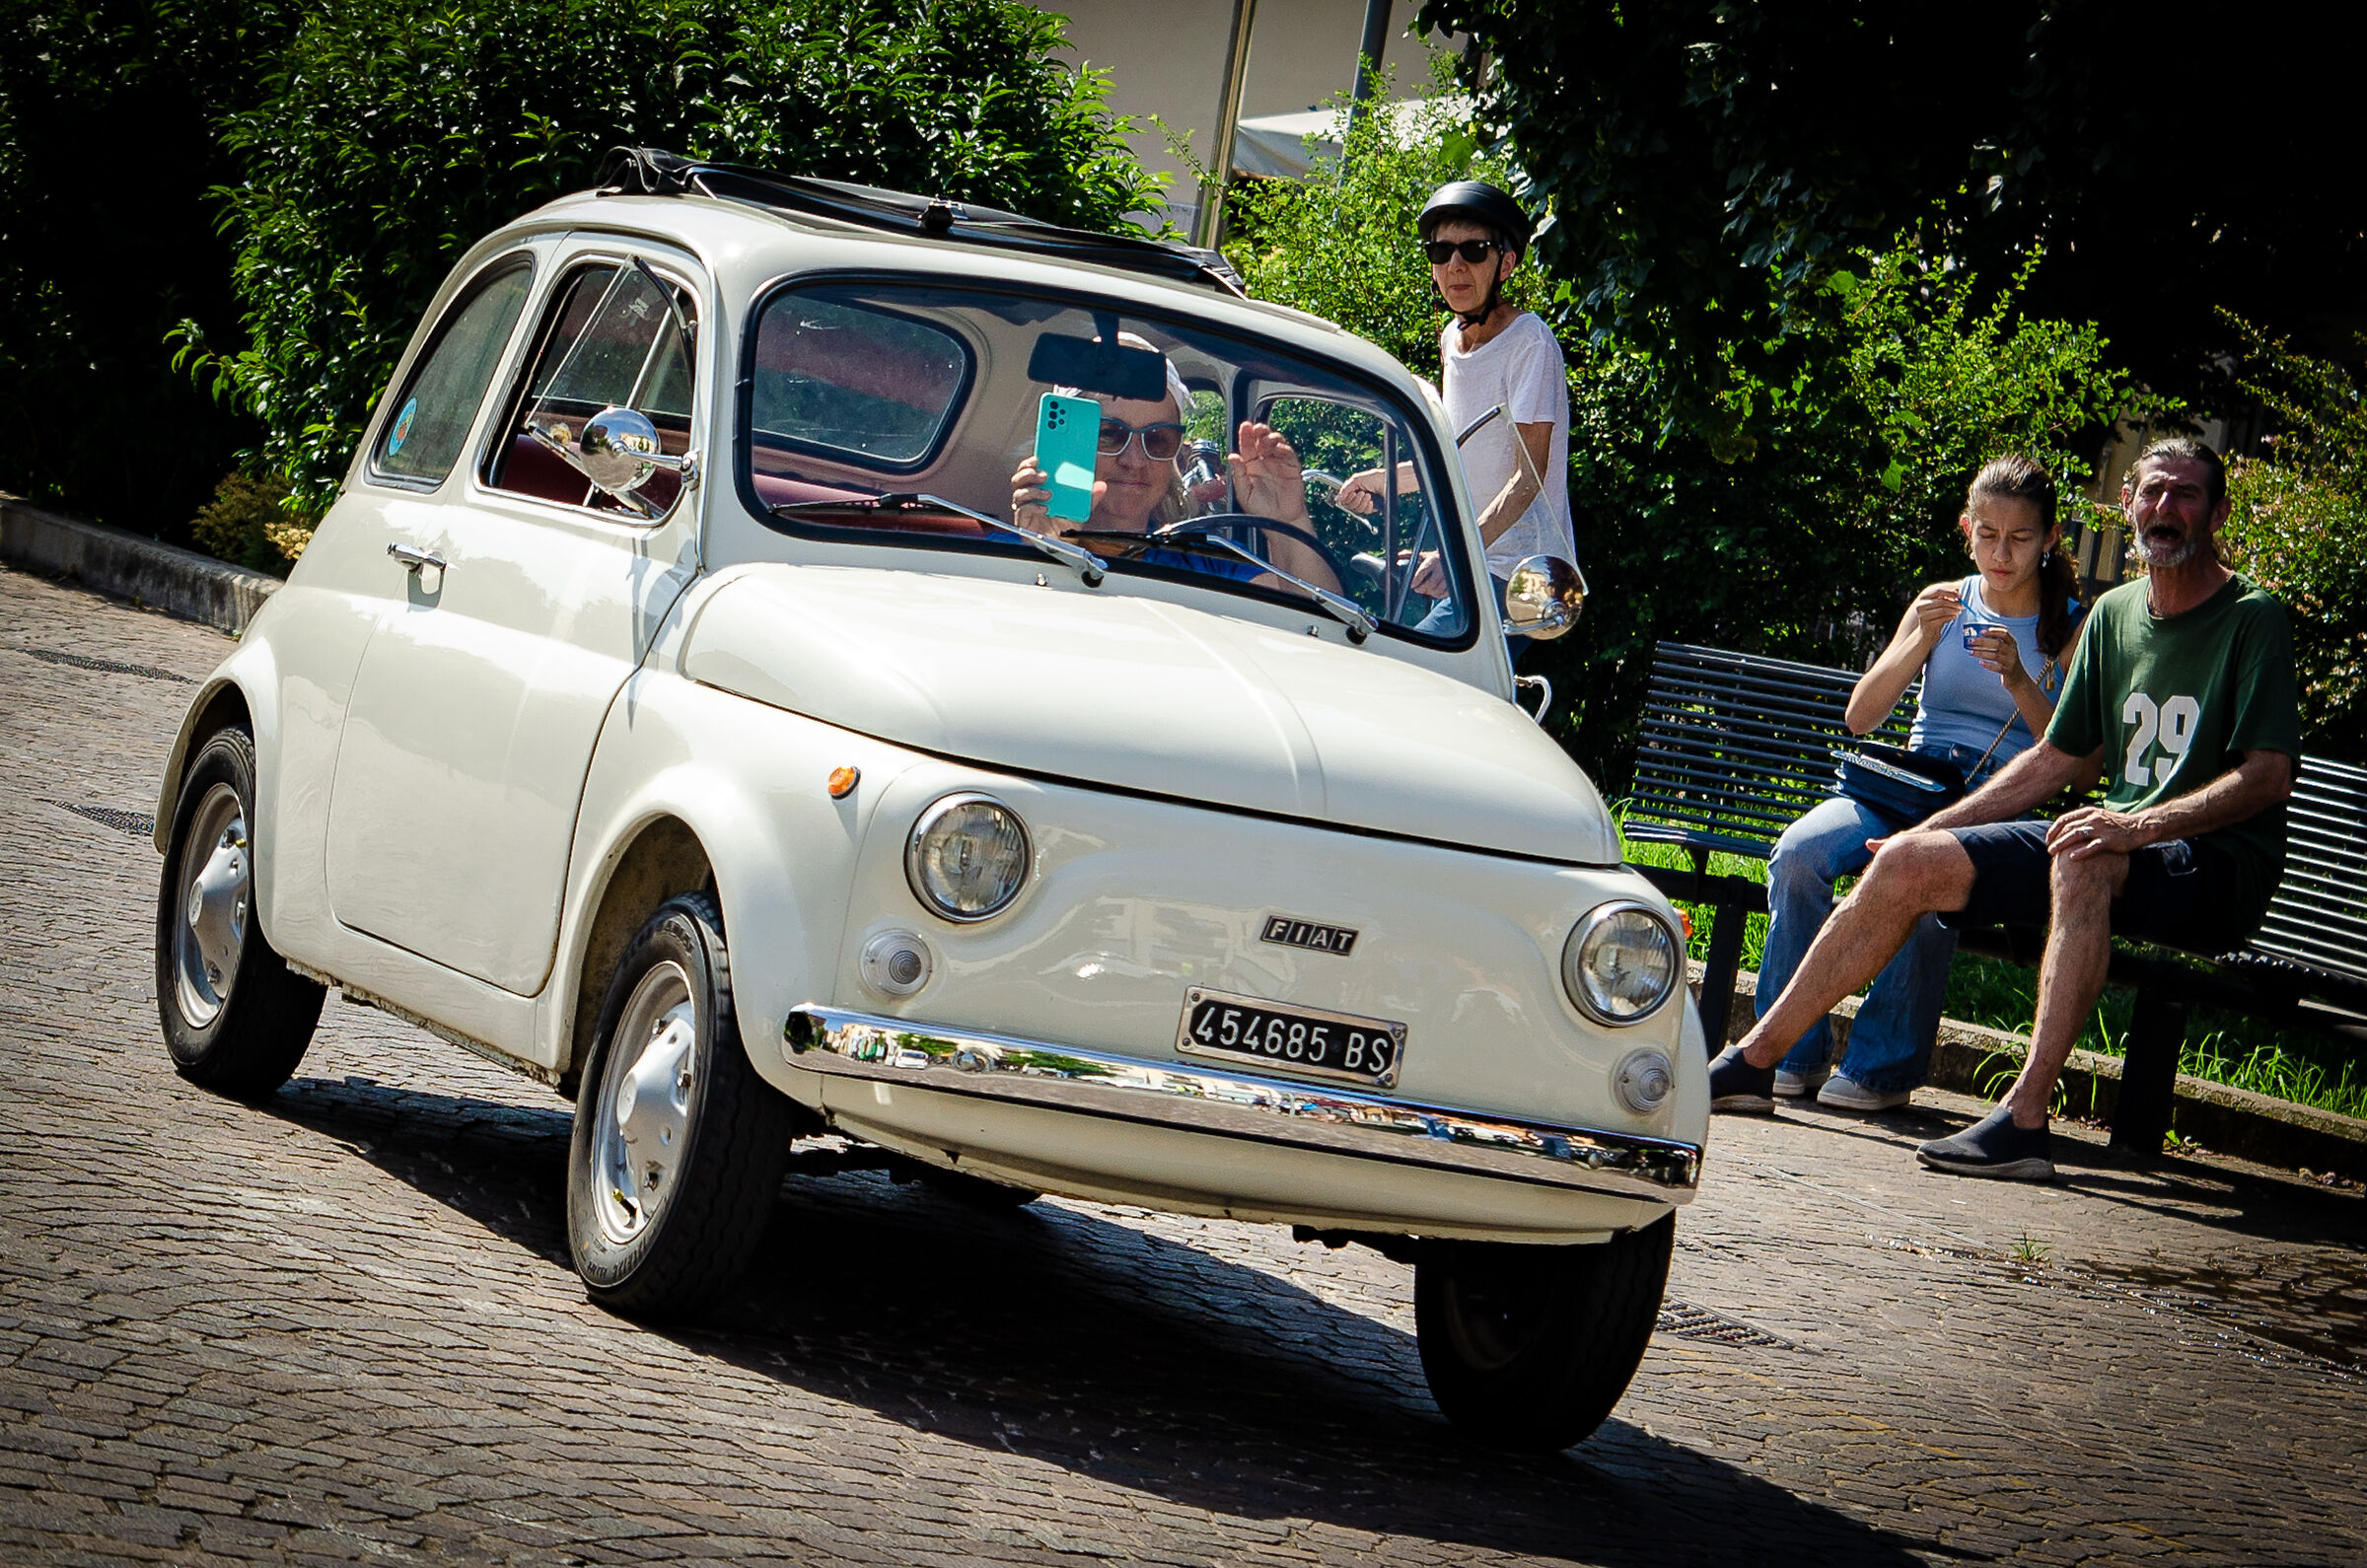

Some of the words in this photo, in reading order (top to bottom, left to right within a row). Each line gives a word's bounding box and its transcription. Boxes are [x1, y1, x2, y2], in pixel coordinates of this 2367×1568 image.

[2122, 692, 2200, 788] 29
[1268, 921, 1353, 951] FIAT
[1195, 1006, 1329, 1062] 454685
[1344, 1032, 1389, 1073] BS
